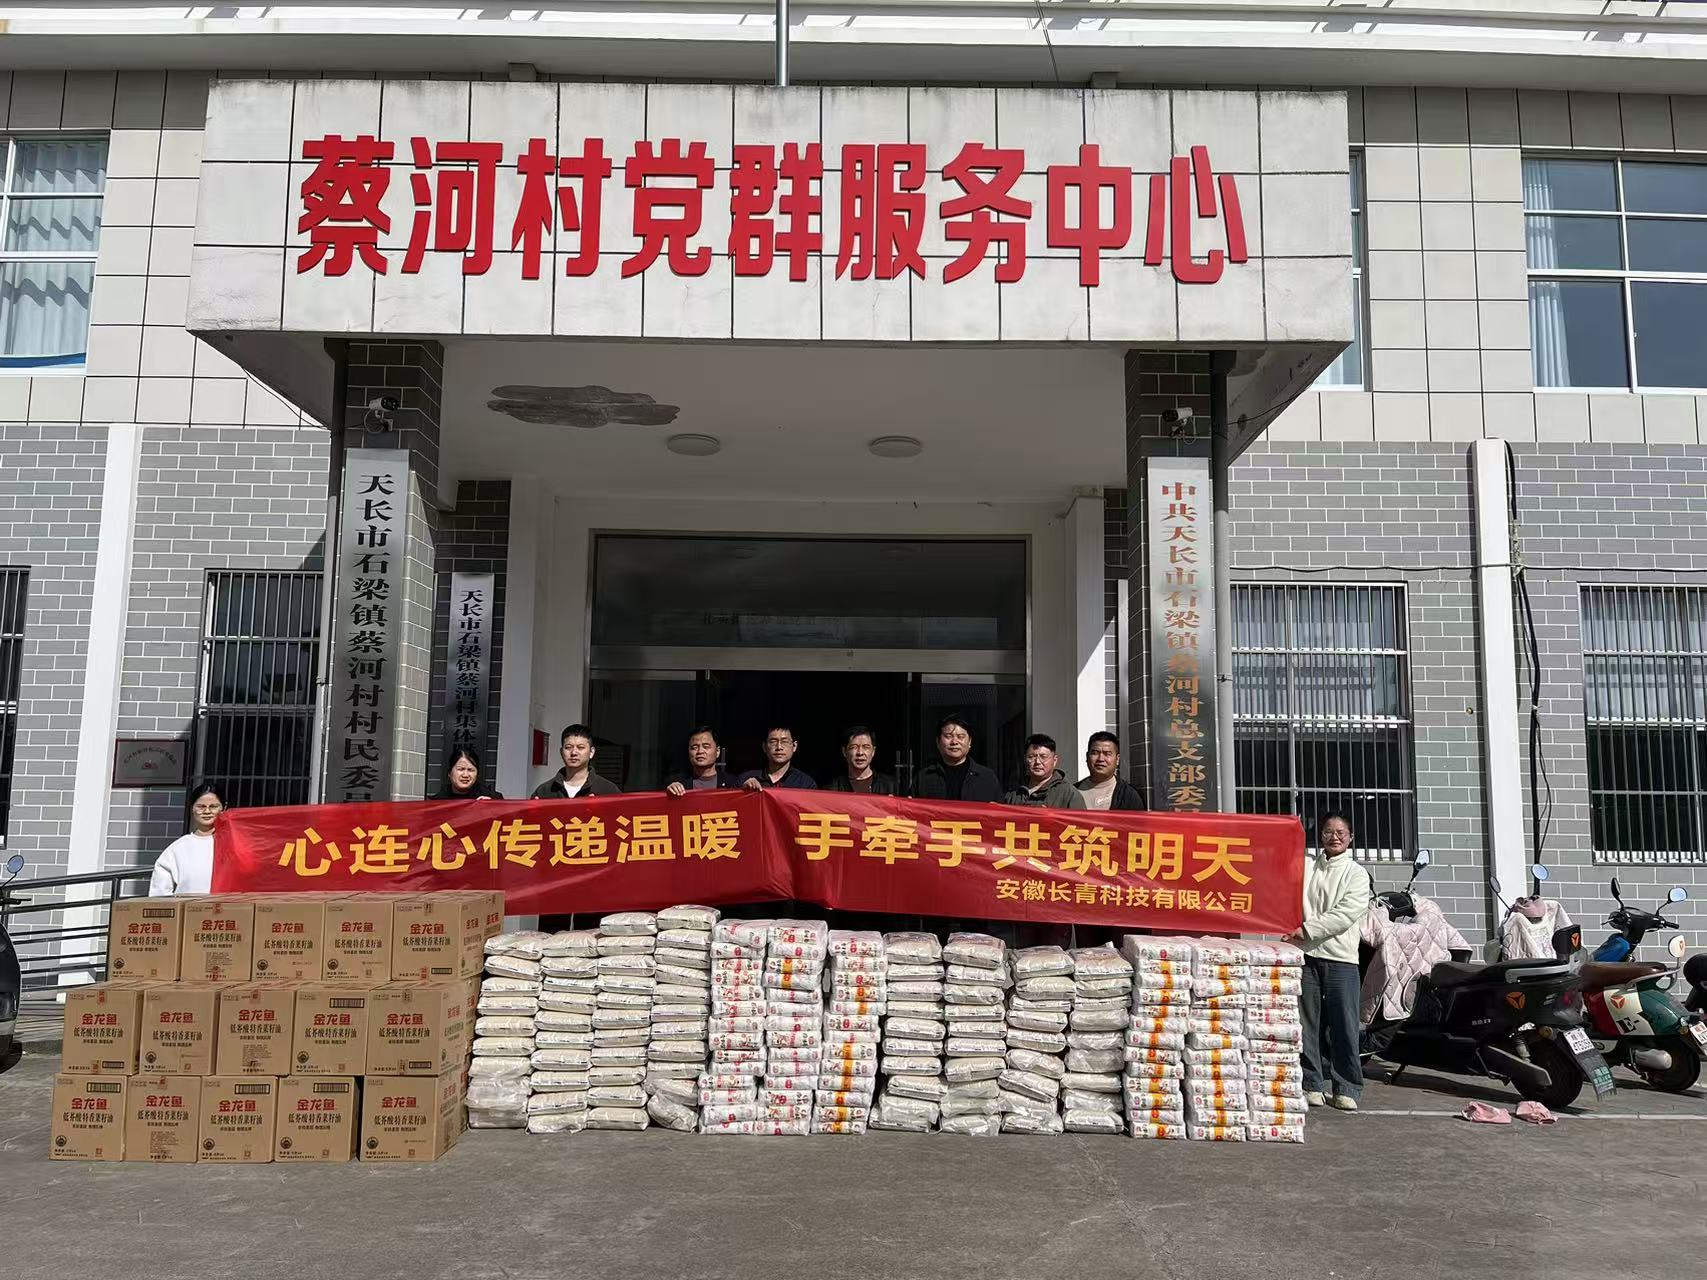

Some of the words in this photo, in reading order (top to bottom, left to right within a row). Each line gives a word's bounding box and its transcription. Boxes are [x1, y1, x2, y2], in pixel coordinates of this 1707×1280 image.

[296, 135, 1249, 286] 蔡河村党群服务中心
[1160, 482, 1207, 811] 中共天长市石梁镇蔡河村总支部委
[278, 810, 741, 877] 心连心传递温暖
[794, 812, 1253, 884] 手牵手共筑明天
[995, 879, 1253, 913] 安徽长青科技有限公司
[128, 923, 162, 934] 金龙鱼
[202, 920, 237, 930] 金龙鱼
[272, 923, 304, 933] 金龙鱼
[342, 922, 374, 932] 金龙鱼
[410, 924, 444, 934] 金龙鱼
[121, 936, 167, 946] 低芥酸特香菜籽油
[194, 933, 242, 942] 低芥酸特香菜籽油
[402, 937, 450, 946] 低芥酸特香菜籽油
[264, 940, 313, 948] 低芥酸特香菜籽油
[335, 938, 382, 948] 低芥酸特香菜籽油
[82, 1014, 117, 1025] 金龙鱼
[160, 1012, 193, 1023] 金龙鱼
[239, 1010, 274, 1021] 金龙鱼
[314, 1014, 350, 1025] 金龙鱼
[387, 1014, 423, 1025] 金龙鱼
[74, 1028, 123, 1038] 低芥酸特香菜籽油
[230, 1024, 281, 1033] 低芥酸特香菜籽油
[305, 1028, 356, 1038] 低芥酸特香菜籽油
[379, 1028, 430, 1037] 低芥酸特香菜籽油
[153, 1030, 202, 1040] 低芥酸特香菜籽油
[72, 1098, 107, 1110] 金龙鱼
[146, 1096, 182, 1107] 金龙鱼
[219, 1100, 256, 1112] 金龙鱼
[298, 1100, 335, 1111] 金龙鱼
[382, 1097, 417, 1108] 金龙鱼
[63, 1112, 113, 1122] 低芥酸特香菜籽油
[138, 1110, 188, 1120] 低芥酸特香菜籽油
[211, 1115, 262, 1124] 低芥酸特香菜籽油
[288, 1113, 341, 1123] 低芥酸特香菜籽油
[374, 1115, 426, 1125] 低芥酸特香菜籽油
